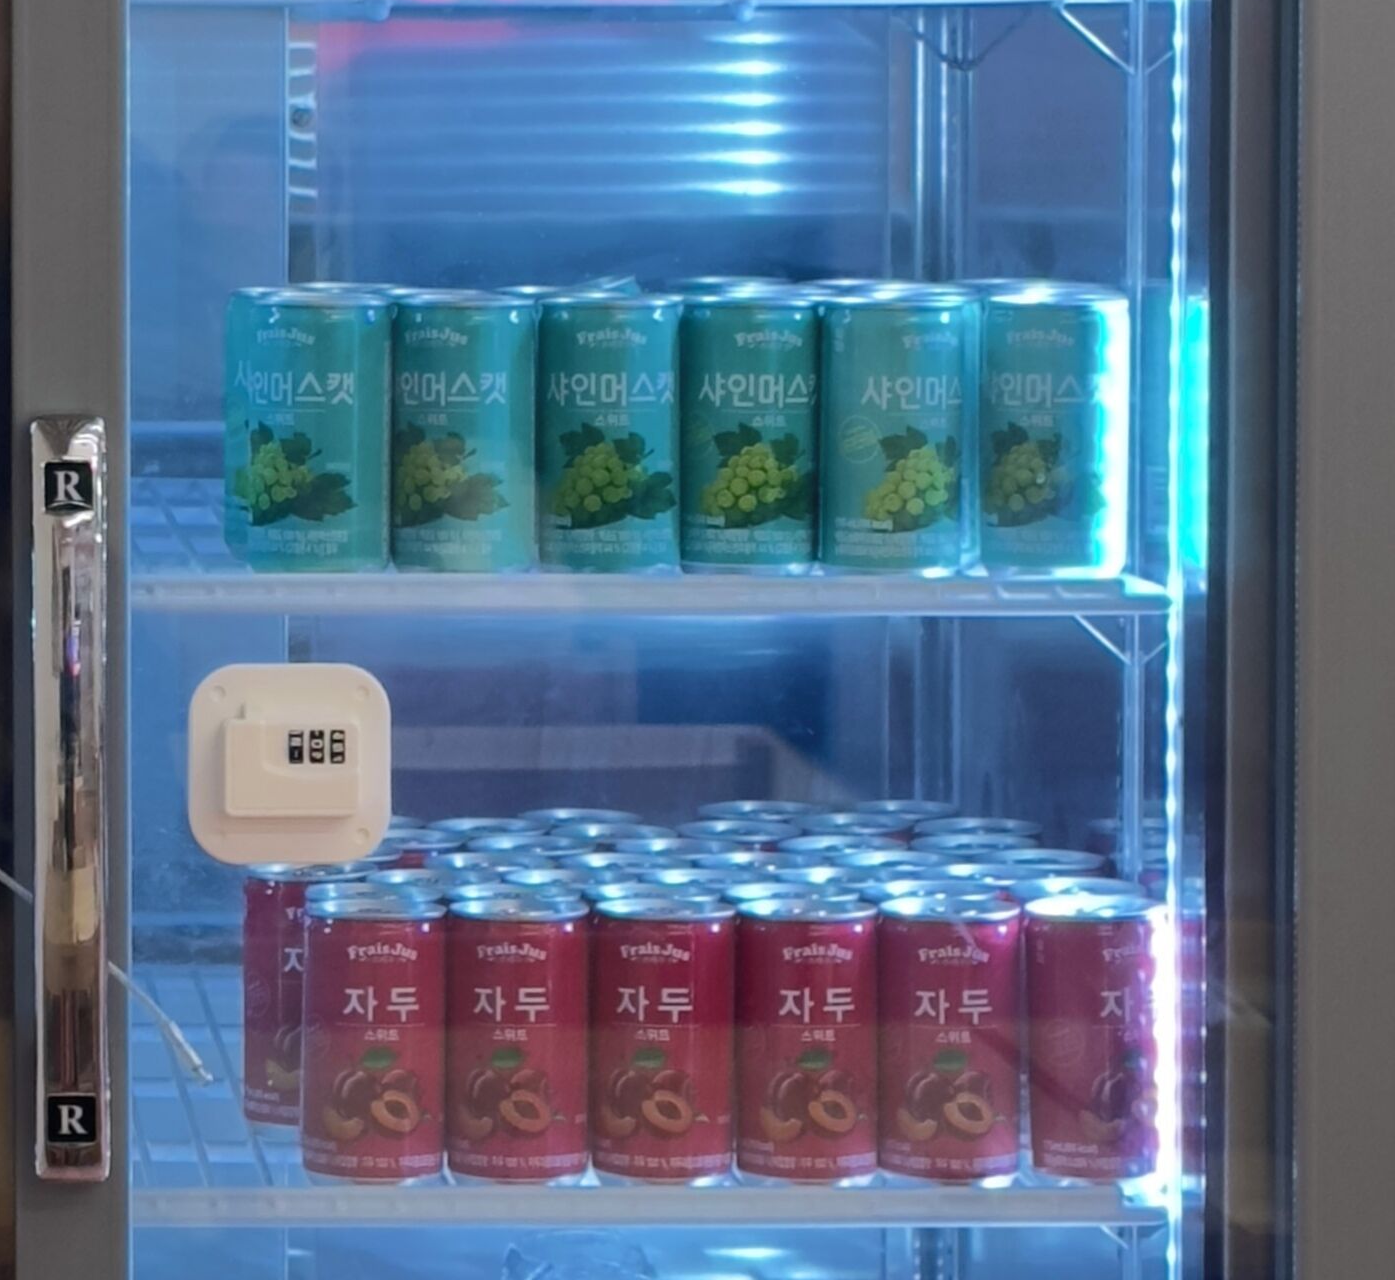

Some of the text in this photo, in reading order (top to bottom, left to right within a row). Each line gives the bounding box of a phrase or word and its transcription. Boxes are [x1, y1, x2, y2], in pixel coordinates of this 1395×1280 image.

[399, 371, 506, 405] 인머스캣
[55, 470, 84, 502] R
[347, 942, 418, 961] FraisJus
[476, 942, 548, 961] FraisJus
[619, 942, 692, 961] FraisJus
[782, 943, 854, 963] FraisJus
[342, 986, 420, 1022] 자두
[473, 986, 551, 1022] 자두
[616, 986, 694, 1023] 자두
[778, 987, 856, 1023] 자두
[914, 989, 994, 1025] 자두
[364, 1027, 400, 1042] 스위트
[492, 1027, 528, 1042] 스위트
[634, 1028, 671, 1042] 스위트
[800, 1028, 837, 1043] 스위트
[935, 1029, 972, 1044] 스위트
[58, 1104, 87, 1135] R
